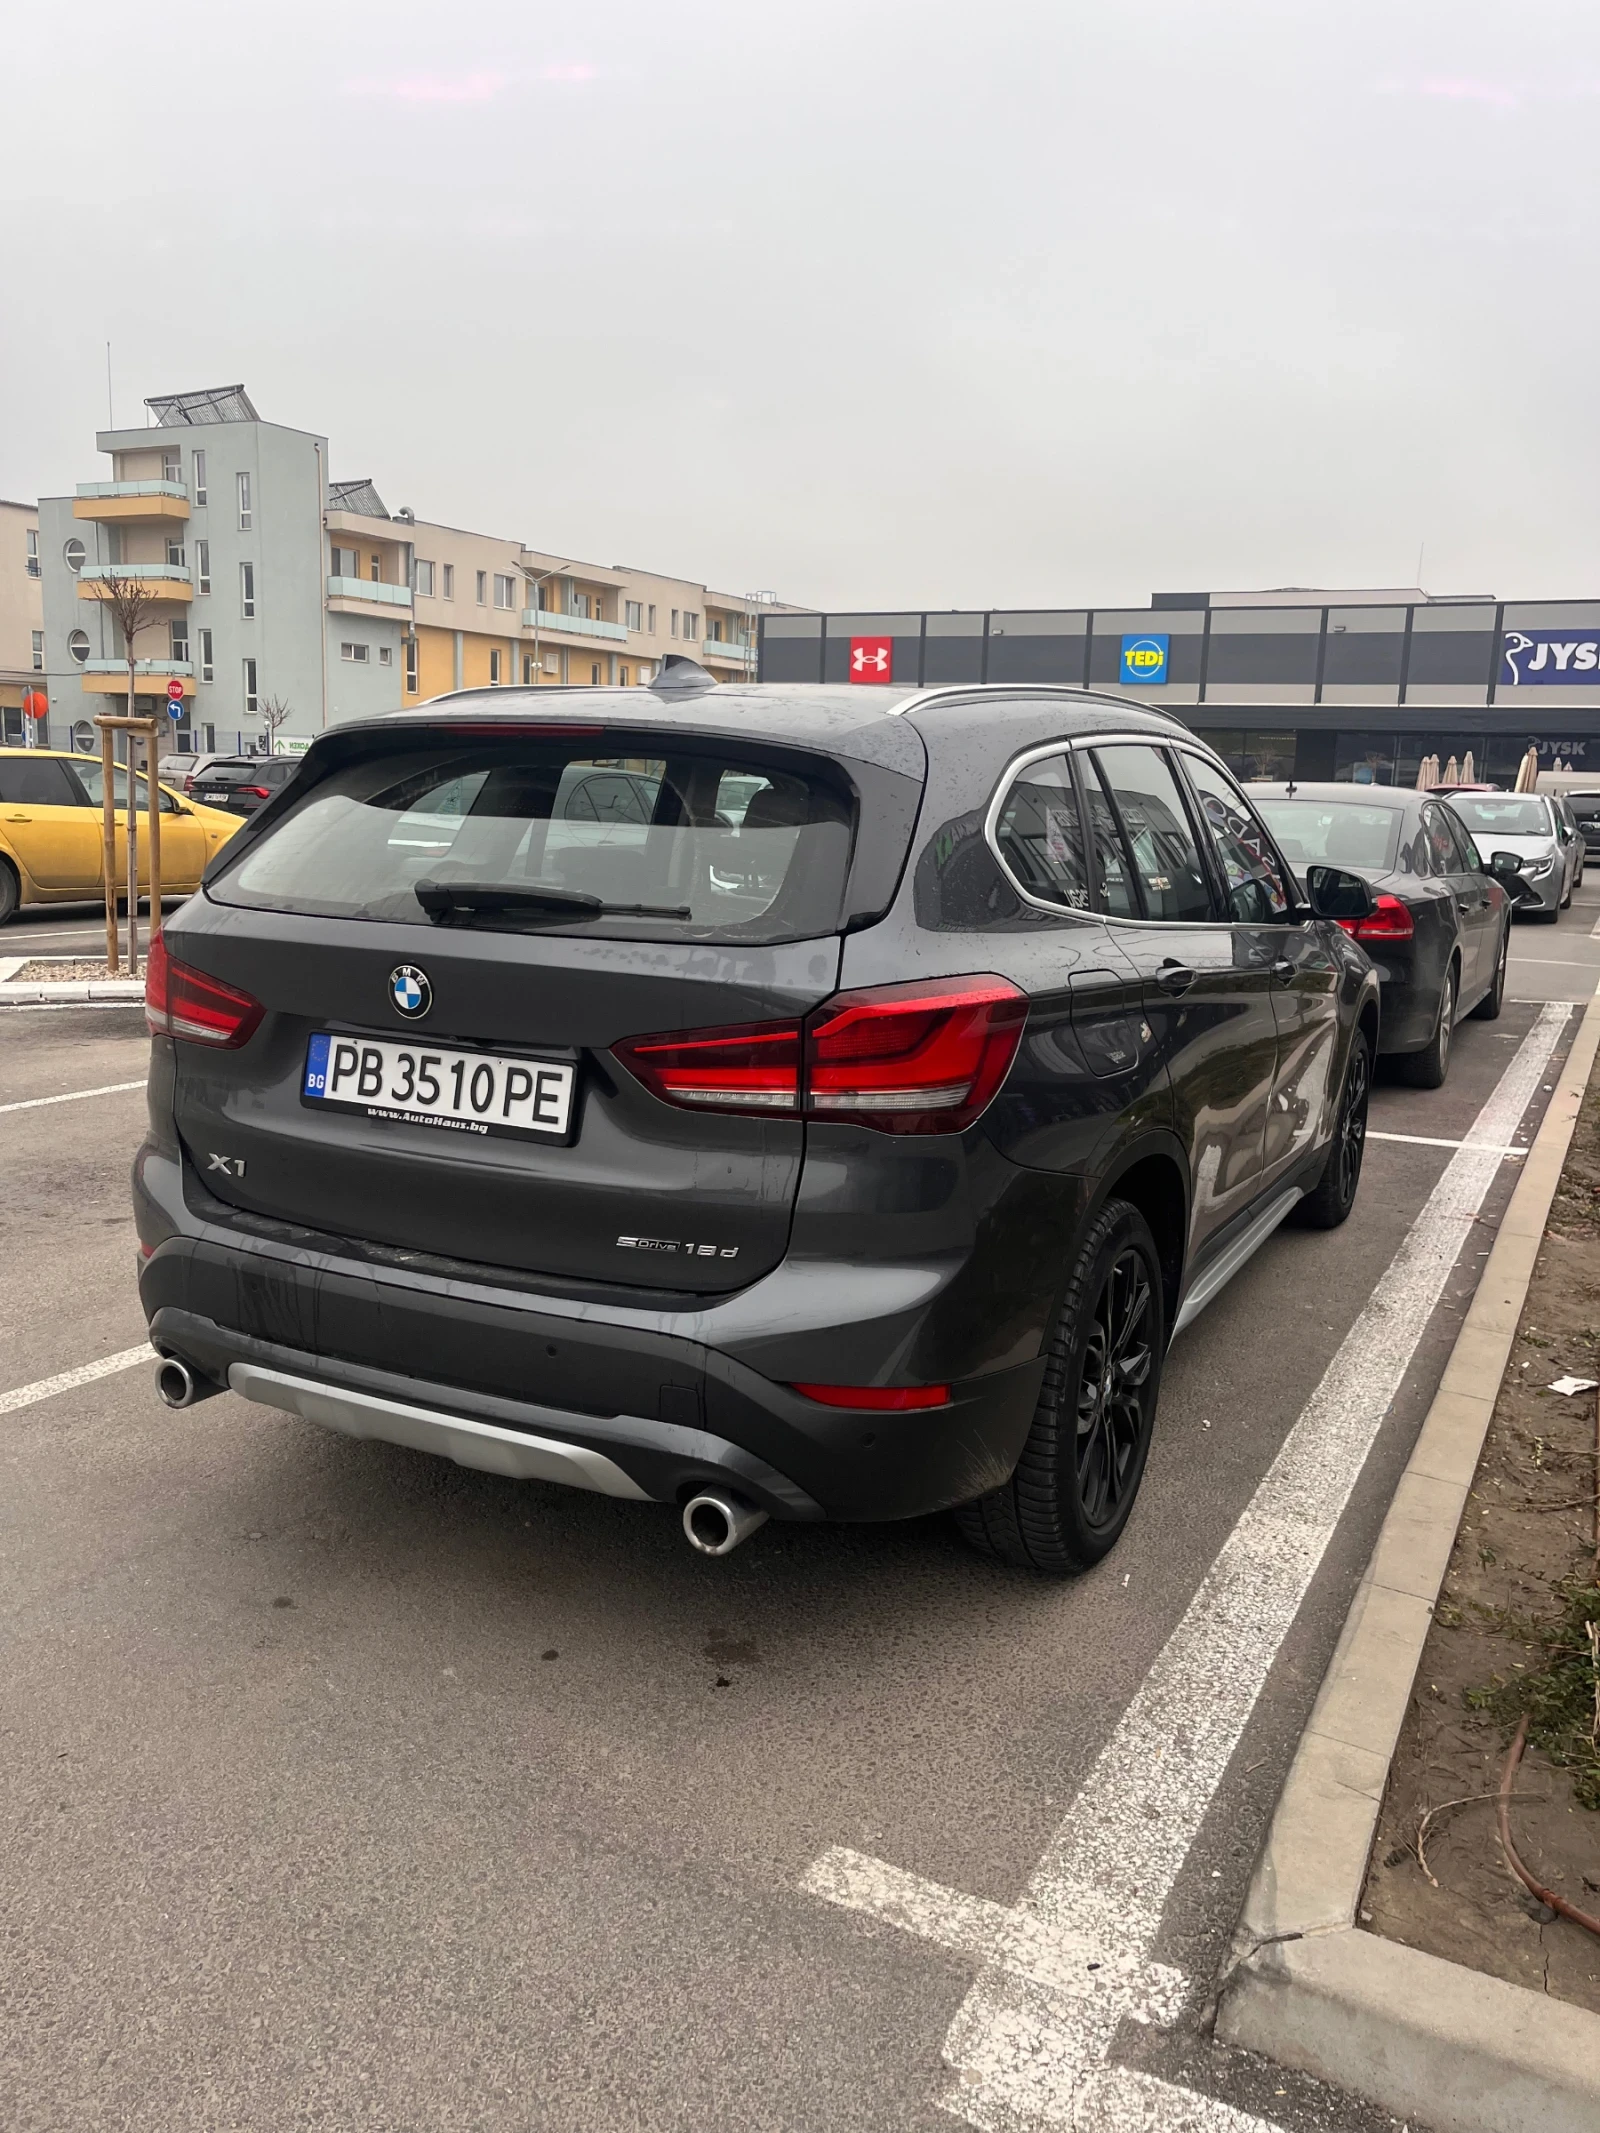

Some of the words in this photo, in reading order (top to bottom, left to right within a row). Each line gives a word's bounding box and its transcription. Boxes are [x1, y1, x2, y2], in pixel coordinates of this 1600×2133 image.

[1124, 650, 1164, 666] TEDi
[1527, 641, 1600, 670] JYS
[169, 685, 182, 694] STOP
[1539, 741, 1585, 756] JYSK
[390, 967, 427, 986] BMW
[308, 1073, 324, 1089] BG
[331, 1043, 384, 1098] PB
[391, 1052, 495, 1114] 3510
[502, 1066, 563, 1125] PE
[367, 1106, 489, 1134] www.AutoHaus.bg
[207, 1152, 245, 1178] X1
